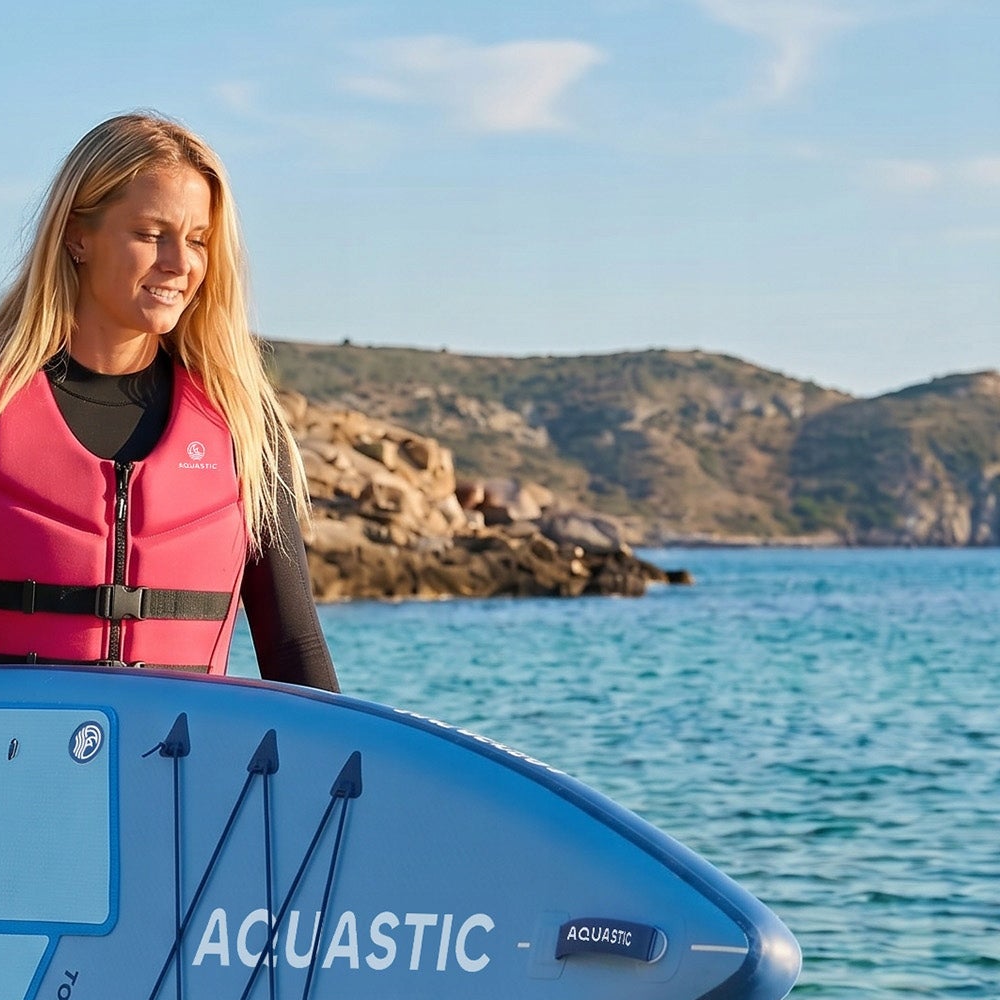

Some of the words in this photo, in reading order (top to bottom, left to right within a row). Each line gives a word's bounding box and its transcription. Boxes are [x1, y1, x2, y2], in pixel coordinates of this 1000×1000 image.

[178, 462, 218, 470] AQUASTIC
[192, 907, 497, 973] AQUASTIC
[566, 925, 632, 947] AQUASTIC
